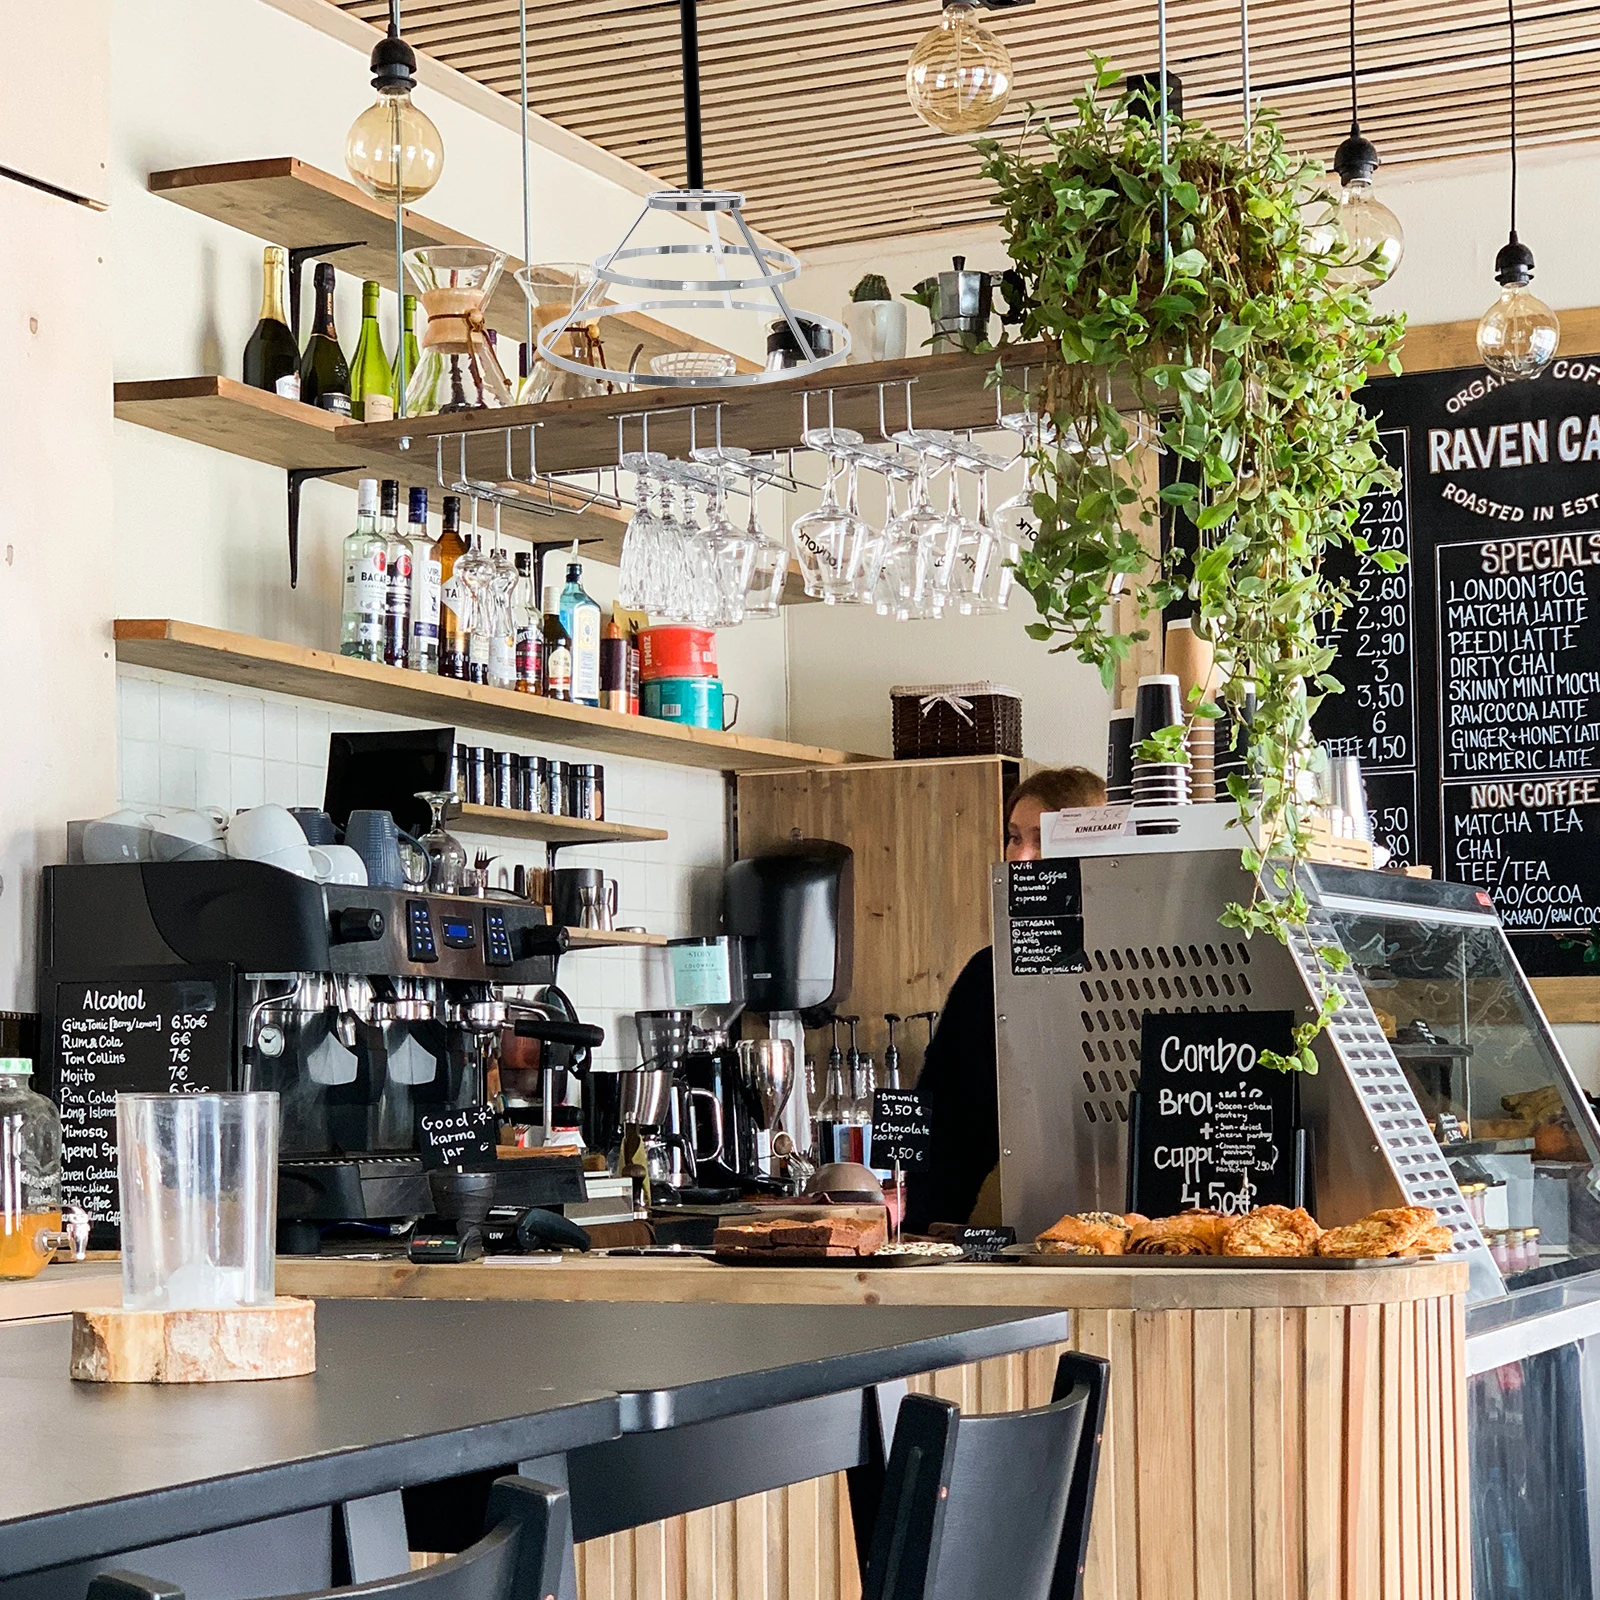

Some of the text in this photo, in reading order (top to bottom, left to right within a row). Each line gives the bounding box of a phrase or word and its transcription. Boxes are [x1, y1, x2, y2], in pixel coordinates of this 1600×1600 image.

[1428, 419, 1550, 474] RAVEN
[1359, 500, 1403, 524] 2,20
[1442, 482, 1525, 522] ROASTED
[1533, 506, 1554, 521] IN
[1362, 527, 1405, 551] 2,20
[1480, 535, 1600, 575] SPECIALS
[1357, 577, 1406, 601] 2,60
[1447, 569, 1586, 603] LONDON FOG
[1356, 604, 1406, 631] 2,90
[1448, 597, 1588, 629] MATCHA LATTE
[1356, 633, 1405, 658] 2,90
[1447, 625, 1580, 655] PEEDI LATTE
[1371, 659, 1389, 683] 3
[1450, 651, 1555, 678] DIRTY CHAI
[1357, 682, 1404, 710] 3,50
[1449, 677, 1510, 701] SKINNY
[1513, 674, 1554, 698] MINT
[1372, 711, 1387, 734] 6
[1449, 698, 1589, 727] RAW COCOA LATTE
[1367, 735, 1406, 763] 1,50
[1449, 746, 1595, 771] TURMERIC LATTE
[1074, 822, 1123, 834] KINKEKAART
[1454, 808, 1584, 837] MATCHA TEA
[1456, 838, 1501, 860] CHAI
[1456, 856, 1550, 885] TEE/TEA
[1486, 883, 1583, 909] AO/COCOA
[83, 989, 146, 1011] Alcohol
[171, 1014, 208, 1031] 6,50€
[170, 1031, 191, 1046] 6€
[61, 1047, 191, 1065] Tom Collins 7€
[1160, 1035, 1256, 1074] Combo
[60, 1065, 188, 1087] Mojito 7€
[60, 1086, 86, 1103] Pina
[881, 1092, 920, 1104] Brownie
[60, 1104, 87, 1125] Long
[421, 1111, 470, 1131] Good
[881, 1103, 912, 1116] 3,50
[430, 1129, 476, 1147] karma
[442, 1146, 465, 1165] jar
